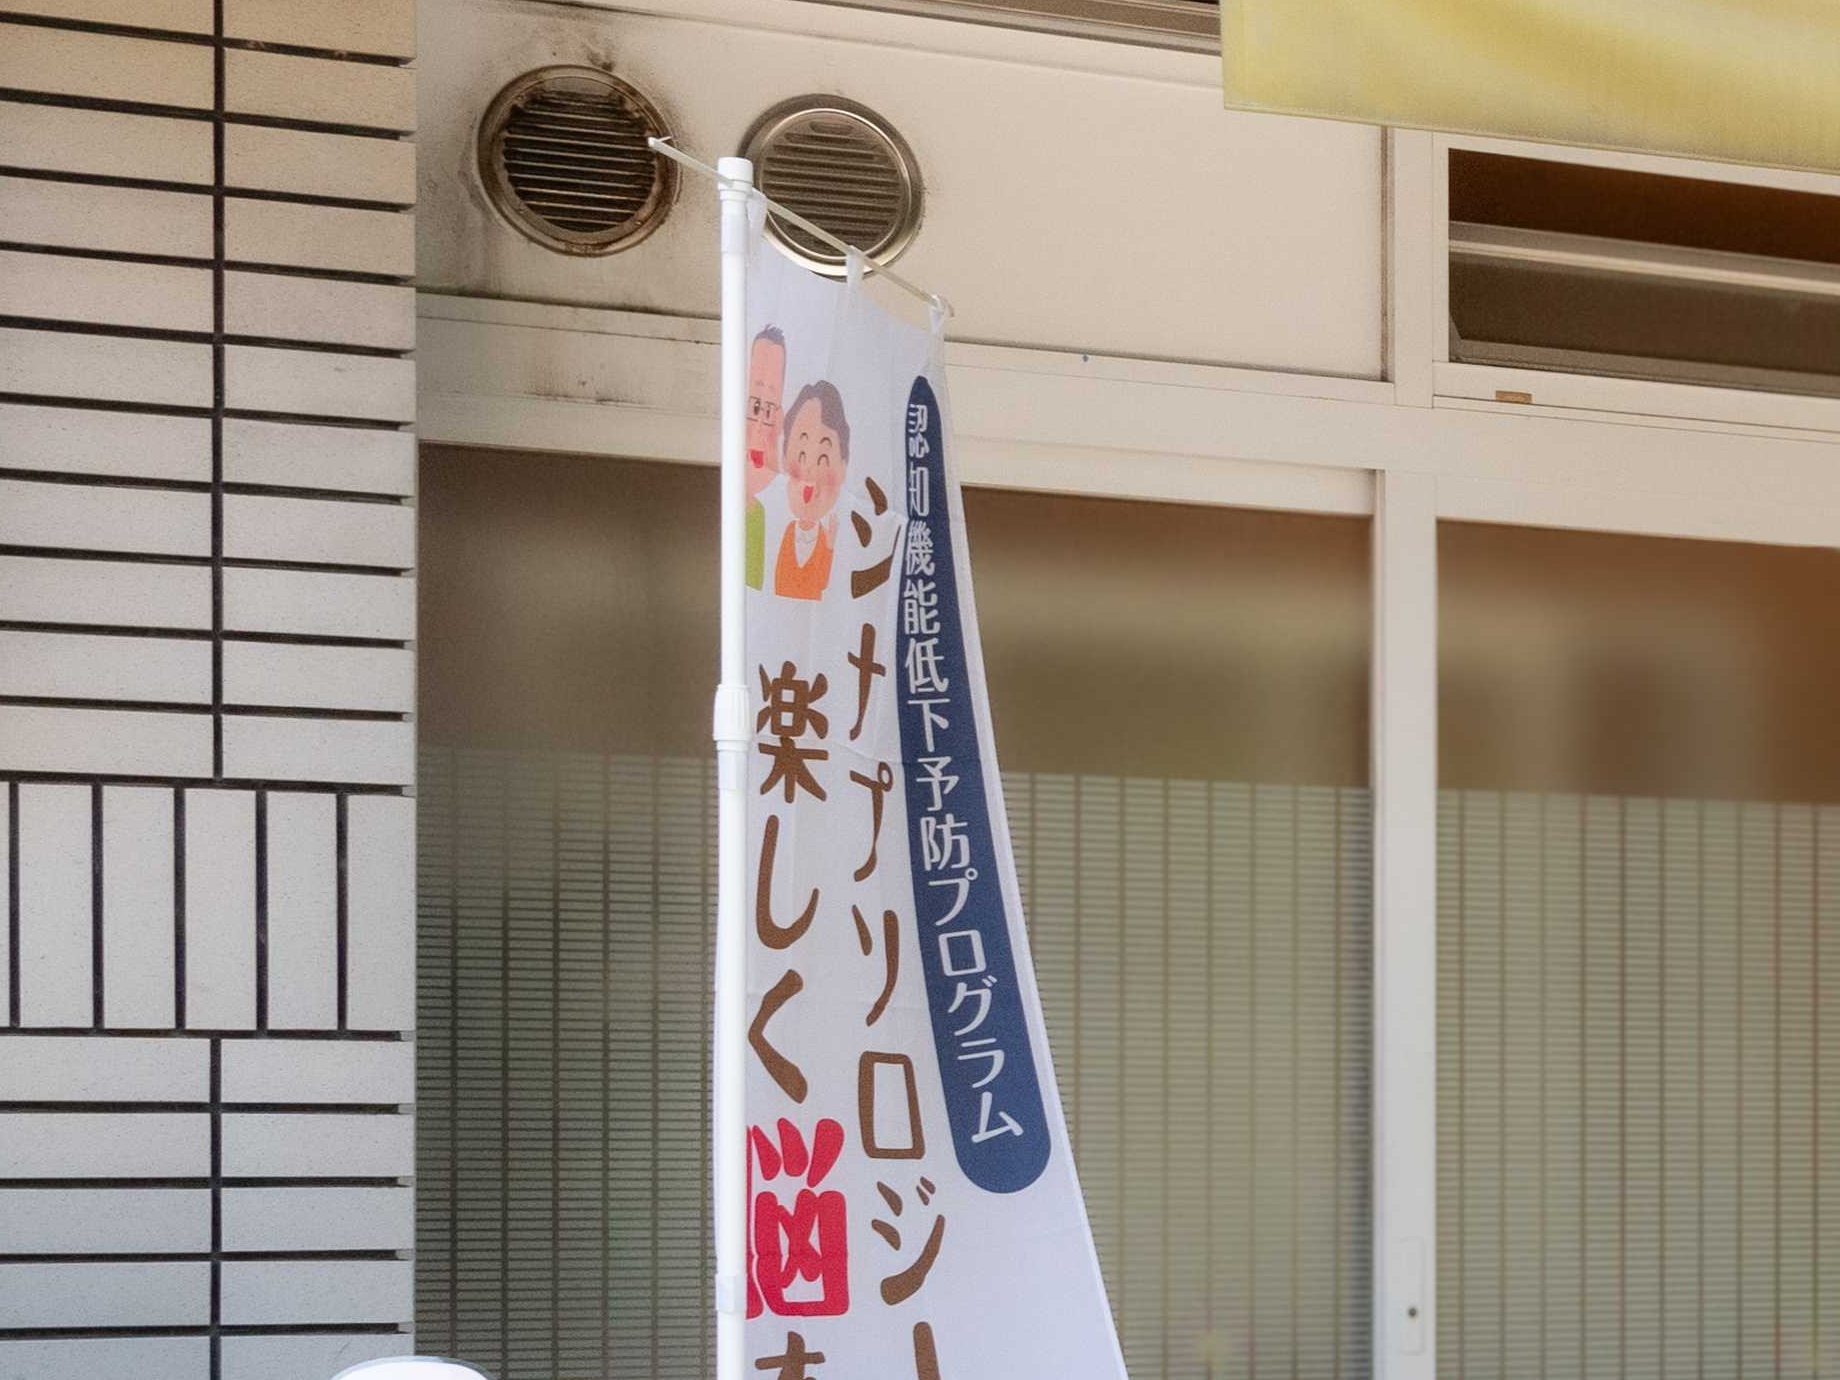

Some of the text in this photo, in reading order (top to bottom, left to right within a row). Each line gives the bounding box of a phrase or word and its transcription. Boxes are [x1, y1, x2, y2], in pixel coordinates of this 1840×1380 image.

[903, 403, 1024, 1144] 認知機能低下予防プログラム
